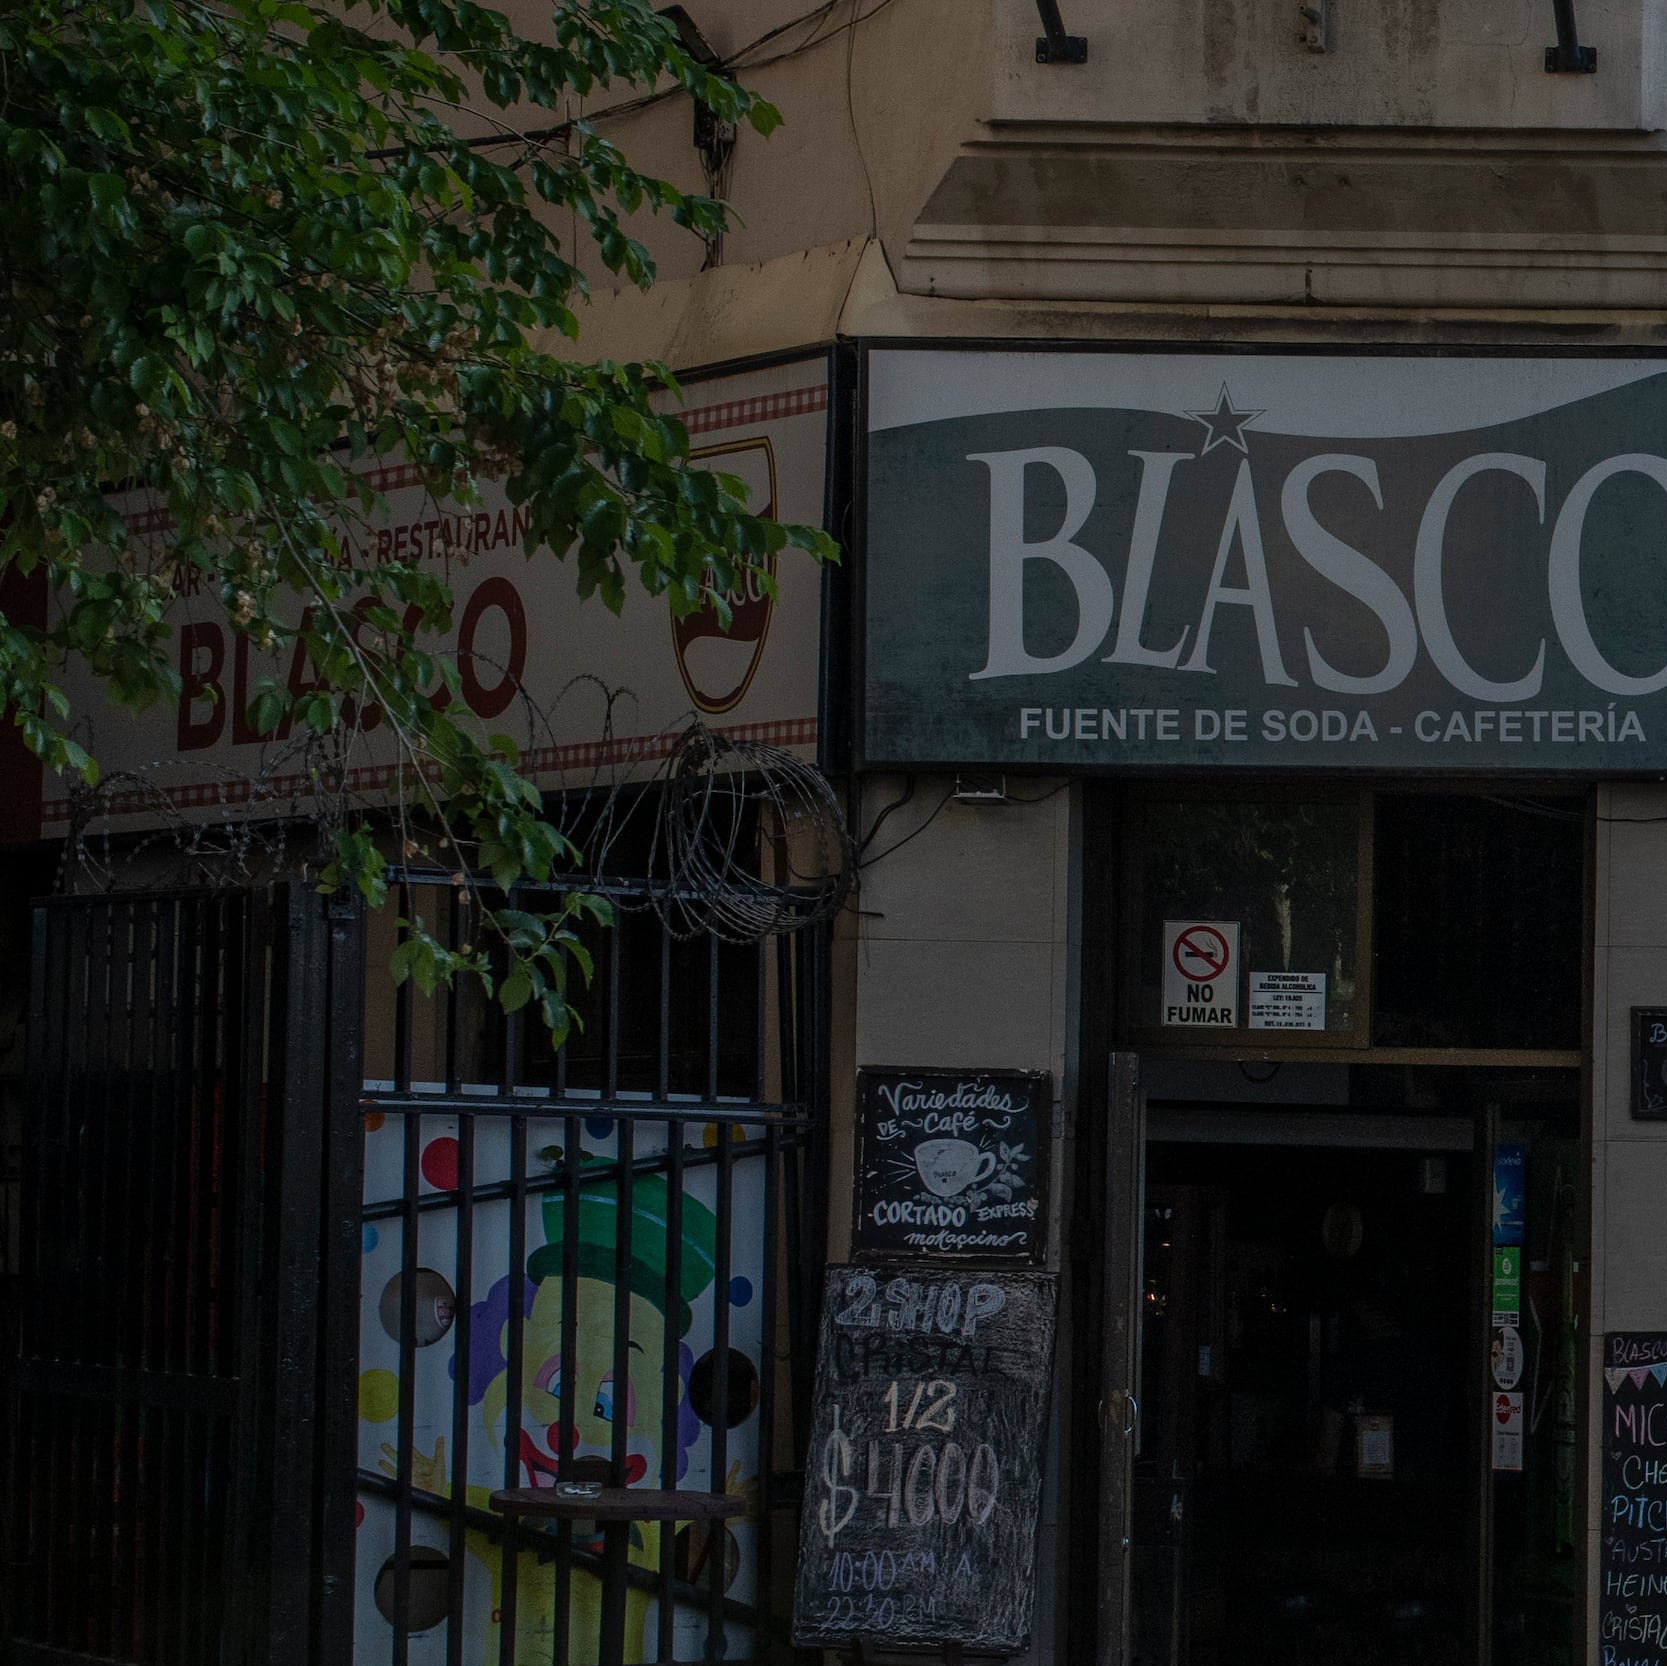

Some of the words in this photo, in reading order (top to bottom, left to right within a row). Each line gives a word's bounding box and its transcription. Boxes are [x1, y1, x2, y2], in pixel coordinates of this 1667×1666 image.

[377, 507, 531, 565] RESTAURAN
[1020, 707, 1179, 742] FUENTE
[1195, 708, 1249, 742] DE
[1261, 708, 1379, 743] SODA
[1414, 702, 1647, 743] CAFETERÍA
[1187, 984, 1214, 1003] NO
[1167, 1007, 1232, 1024] FUMAR
[878, 1080, 1029, 1116] Variedades
[877, 1118, 899, 1137] DE
[923, 1111, 981, 1137] Café
[873, 1200, 967, 1228] CORTADO
[883, 1380, 957, 1434] 1/2
